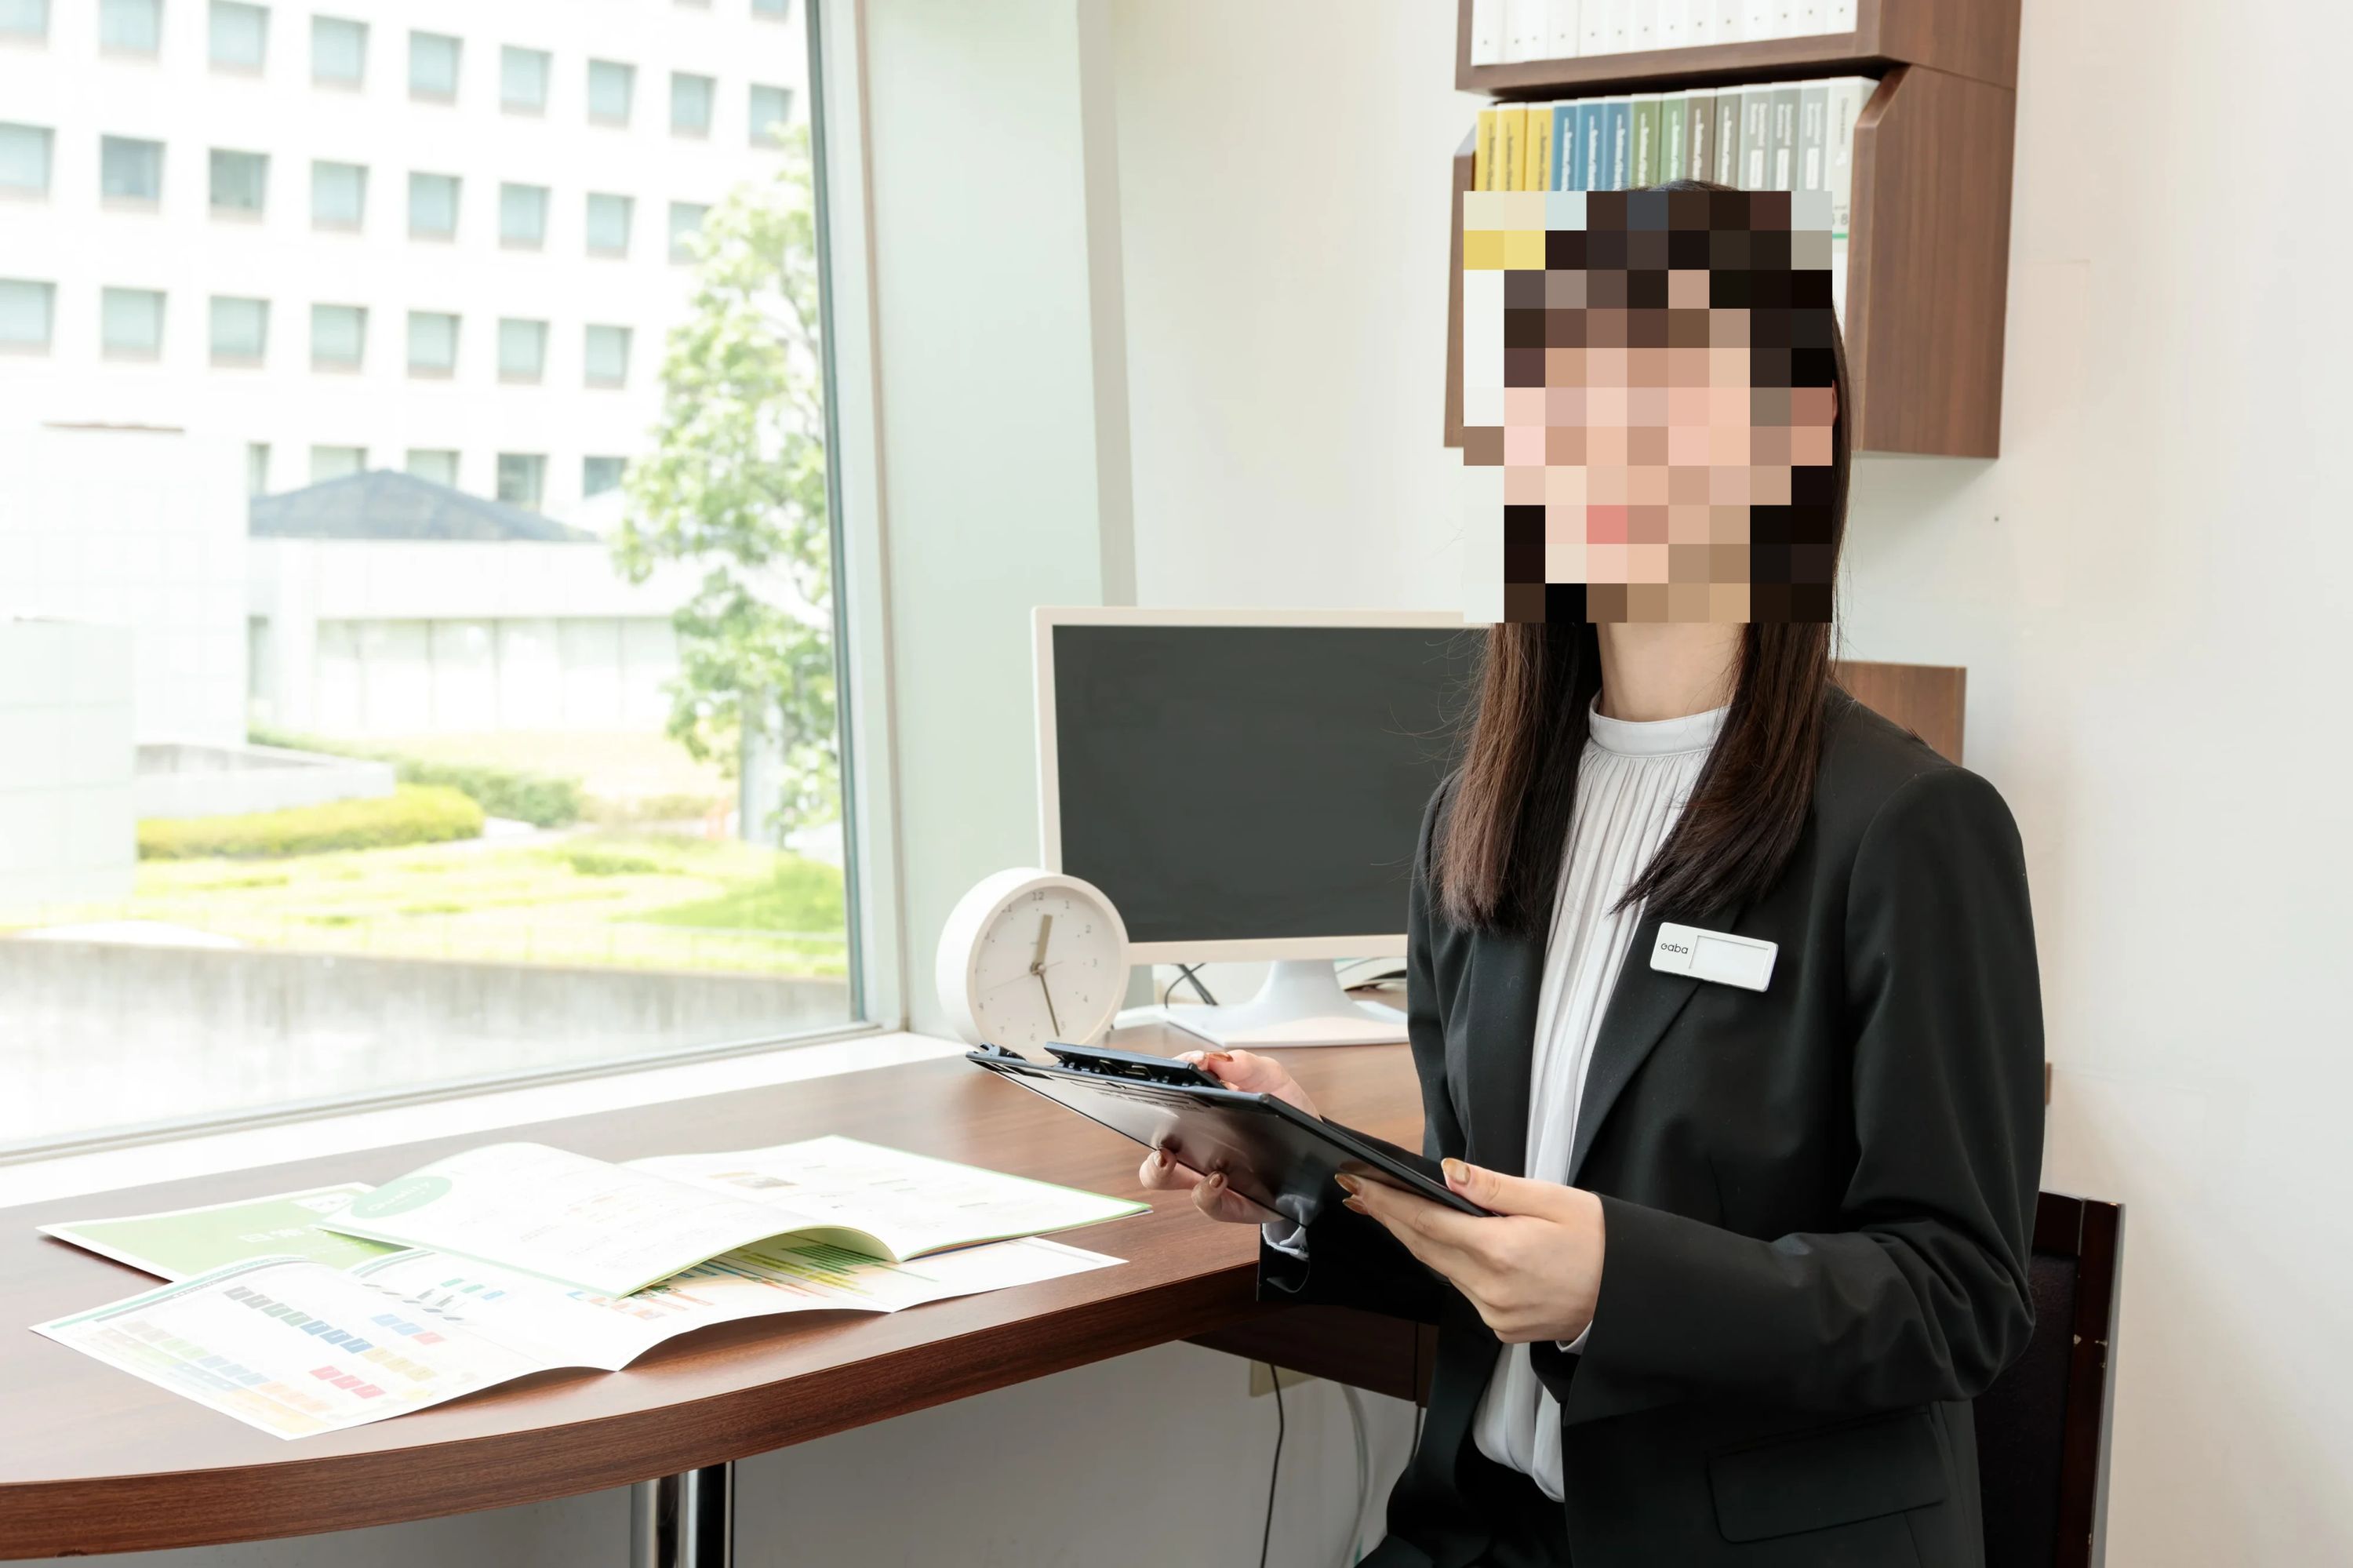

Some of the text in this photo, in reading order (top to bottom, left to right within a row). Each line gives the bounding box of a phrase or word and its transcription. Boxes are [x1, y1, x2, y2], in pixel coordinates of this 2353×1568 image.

[1032, 892, 1045, 901] 12
[1065, 900, 1070, 910] 1
[1086, 925, 1092, 934] 2
[1093, 958, 1097, 967] 3
[1083, 995, 1089, 1004] 4
[1030, 1033, 1036, 1042] 6
